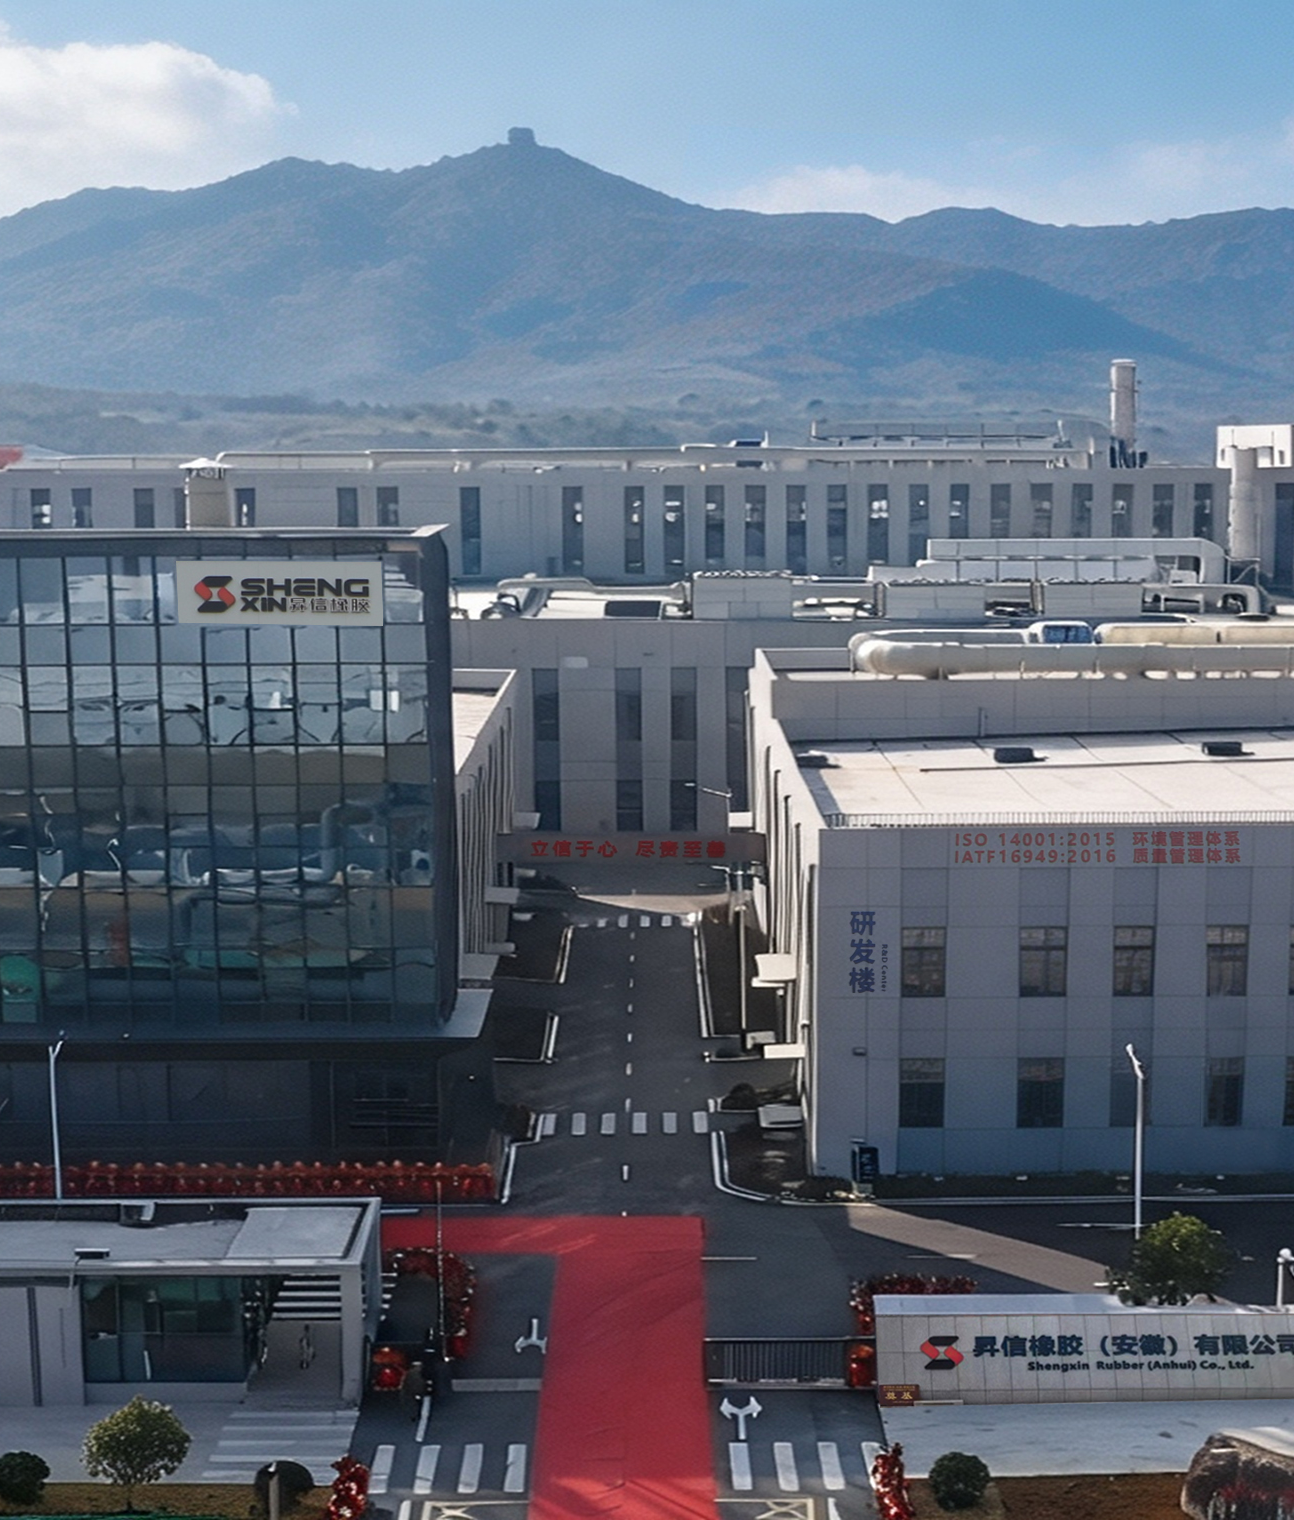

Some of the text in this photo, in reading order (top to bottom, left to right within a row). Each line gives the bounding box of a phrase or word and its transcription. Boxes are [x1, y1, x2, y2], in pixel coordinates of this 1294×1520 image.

[240, 577, 370, 597] SHENG
[240, 597, 371, 613] XIN 昇信橡胶
[954, 830, 1240, 847] ISO 14001:2015 环境管理体系
[531, 840, 618, 858] 立信于心
[954, 848, 1241, 864] IATF16949:2016 质量管理体系
[849, 911, 876, 993] 研发楼
[1027, 1360, 1255, 1372] Shengxin Rubber (Anhui) Co., Ltd.
